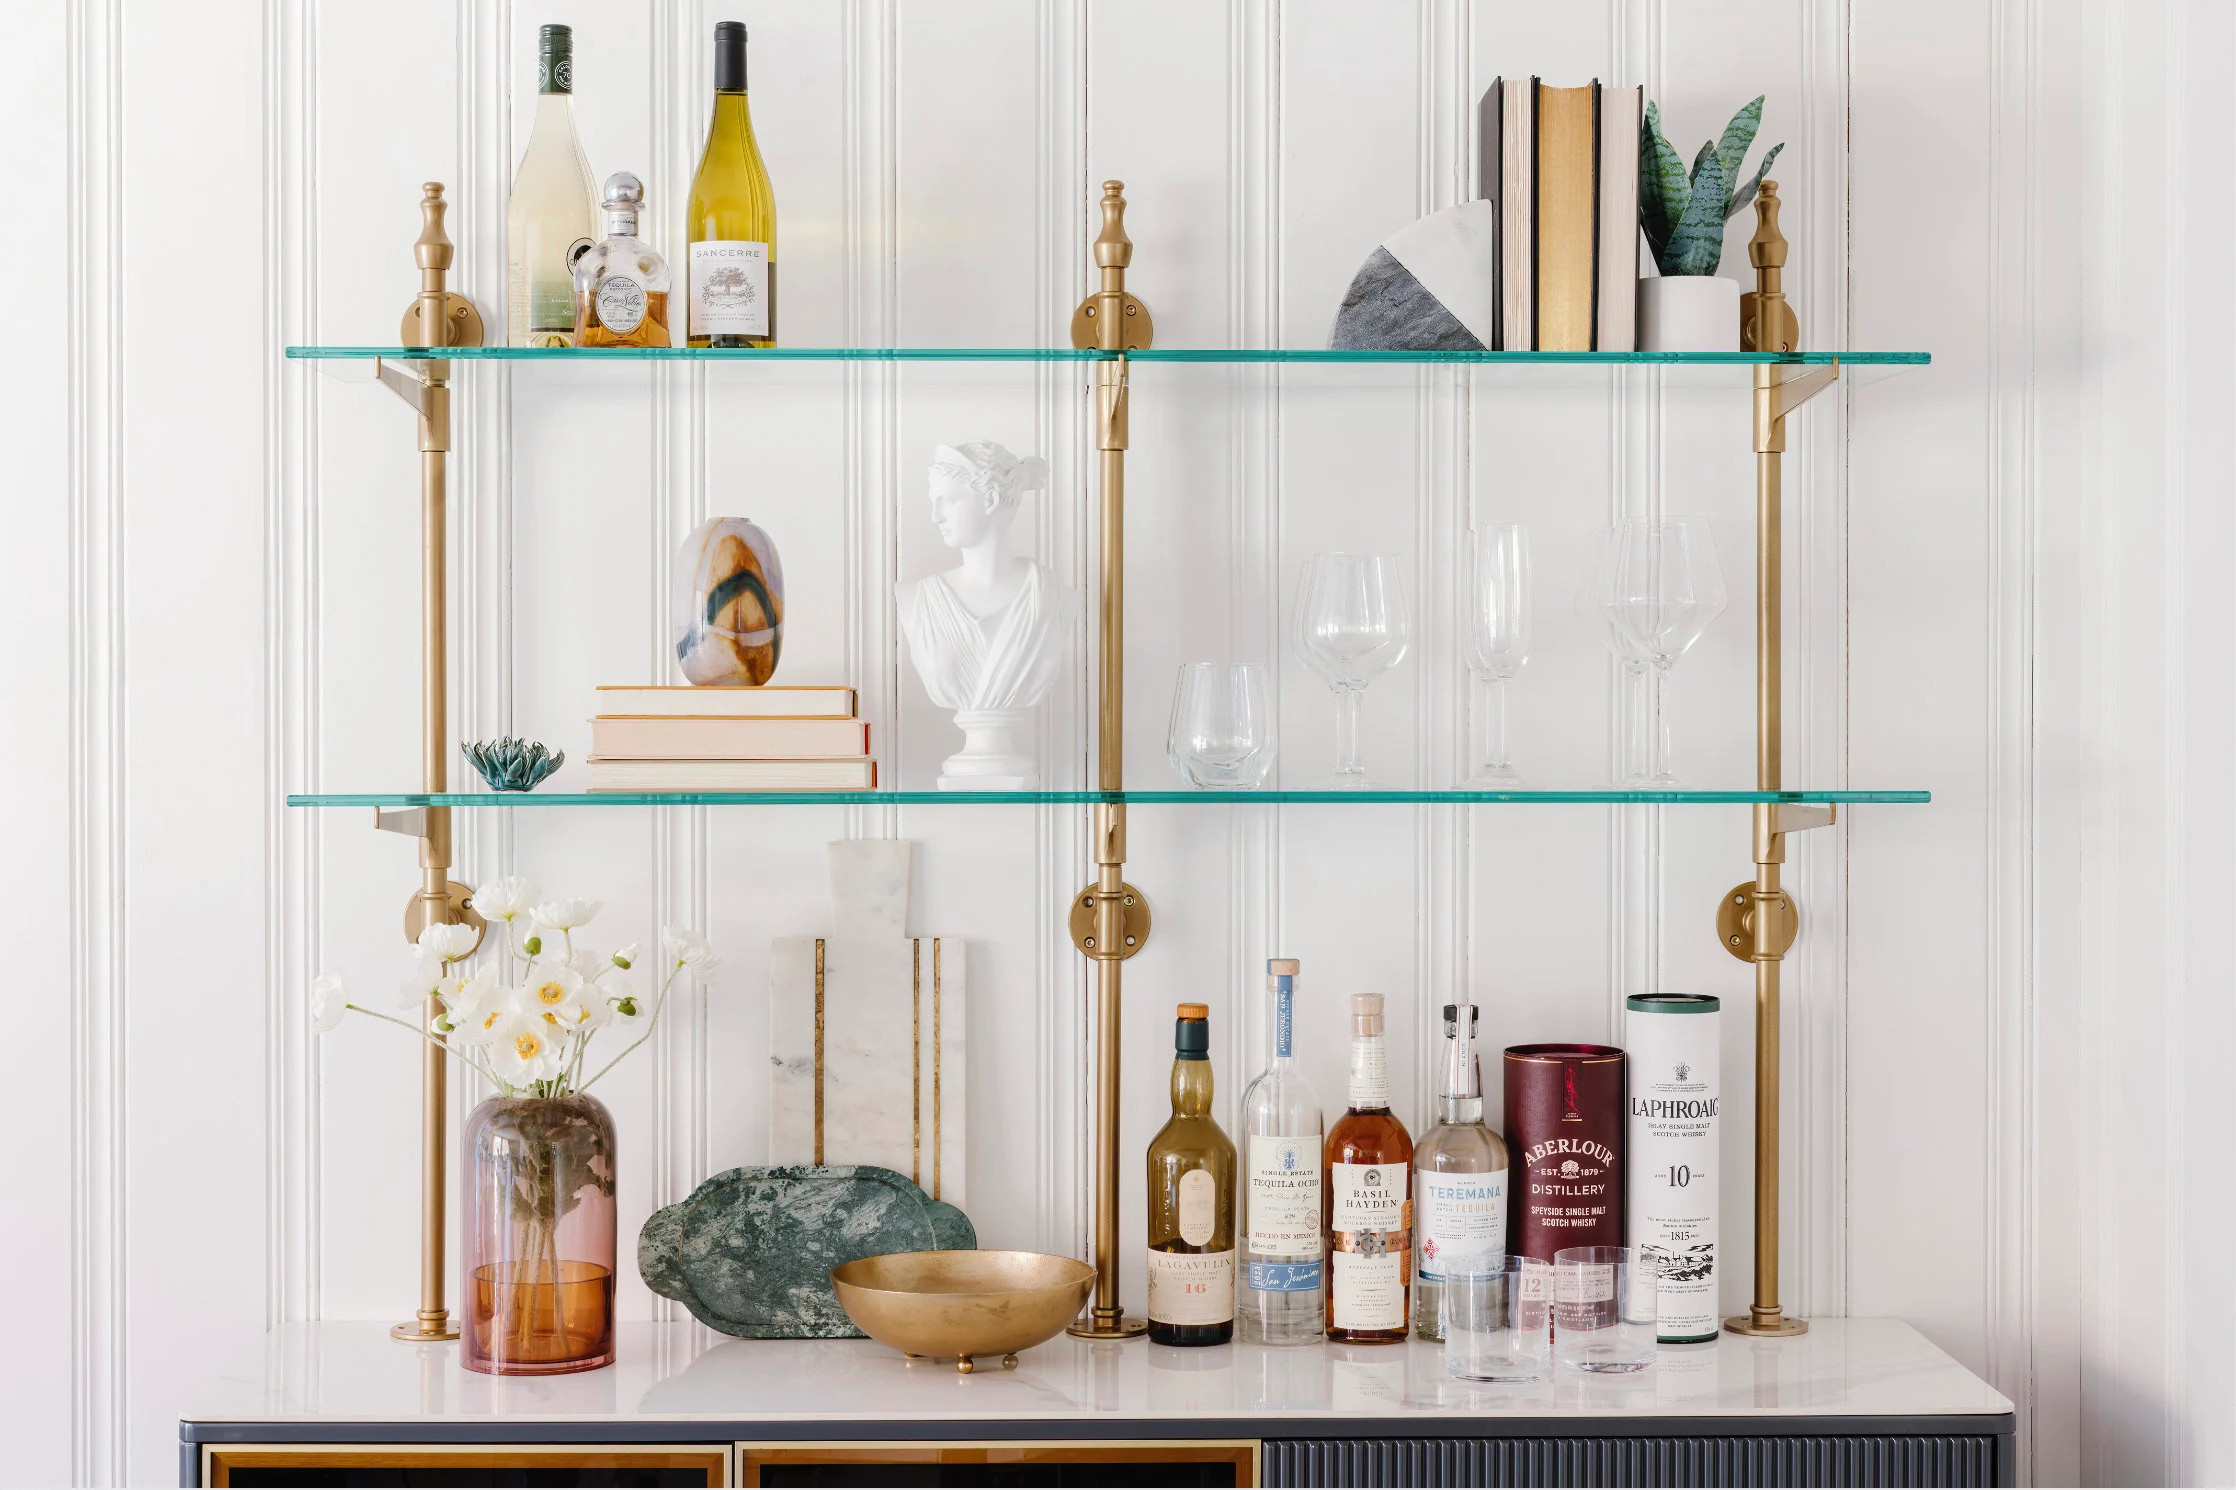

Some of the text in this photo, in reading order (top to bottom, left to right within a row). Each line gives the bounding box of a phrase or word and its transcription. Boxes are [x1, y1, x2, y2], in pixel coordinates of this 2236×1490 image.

[696, 249, 760, 258] SANCERRE
[1632, 1097, 1719, 1118] LAPHROAIG
[1524, 1138, 1615, 1167] ABERLOUR
[1541, 1168, 1599, 1176] EST. 1879
[1669, 1164, 1690, 1187] 10
[1253, 1178, 1319, 1188] TEQUILA OCHO
[1353, 1190, 1391, 1198] BASIL
[1428, 1186, 1501, 1200] TEREMANA
[1532, 1184, 1606, 1196] DISTILLERY
[1346, 1200, 1397, 1208] HAYDEN
[1455, 1203, 1495, 1213] TEQUILA
[1531, 1206, 1606, 1216] SPEYSIDE SINGLE MALT
[1542, 1218, 1597, 1227] SCOTCH WHISKY
[1293, 1232, 1316, 1240] MEXICO
[1671, 1231, 1690, 1240] 1815
[1158, 1259, 1232, 1270] LAGAVULIN
[1185, 1283, 1207, 1294] 16
[1525, 1278, 1541, 1293] 12
